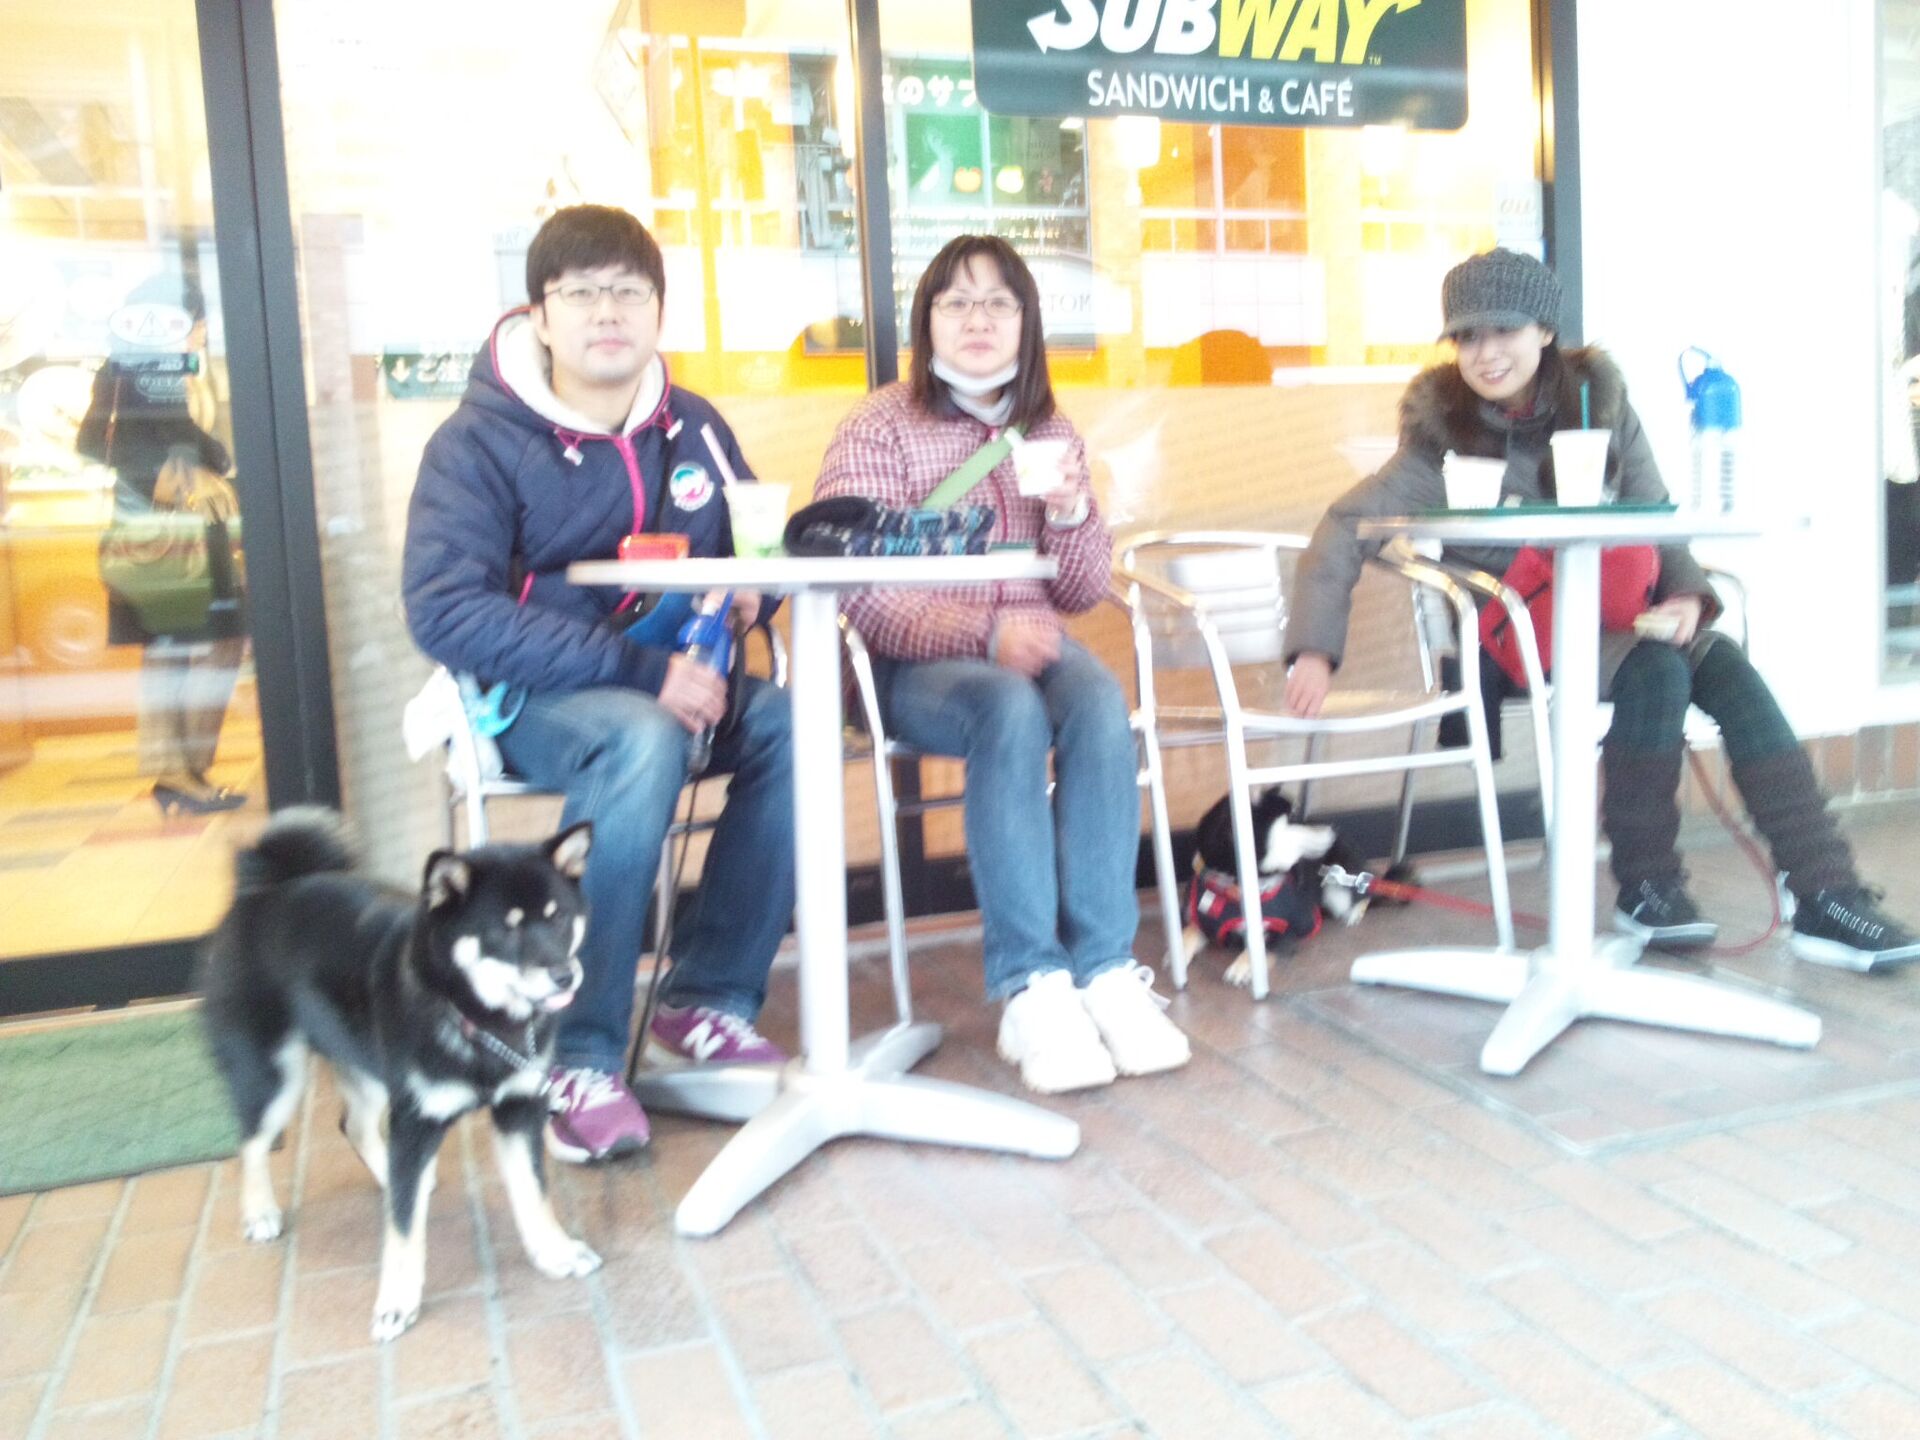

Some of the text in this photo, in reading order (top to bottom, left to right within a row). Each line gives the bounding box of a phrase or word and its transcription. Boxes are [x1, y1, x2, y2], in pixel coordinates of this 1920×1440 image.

[1026, 0, 1421, 65] SUBWAY
[1086, 68, 1355, 117] SANDWICH & CAFÉ
[682, 1020, 727, 1061] N
